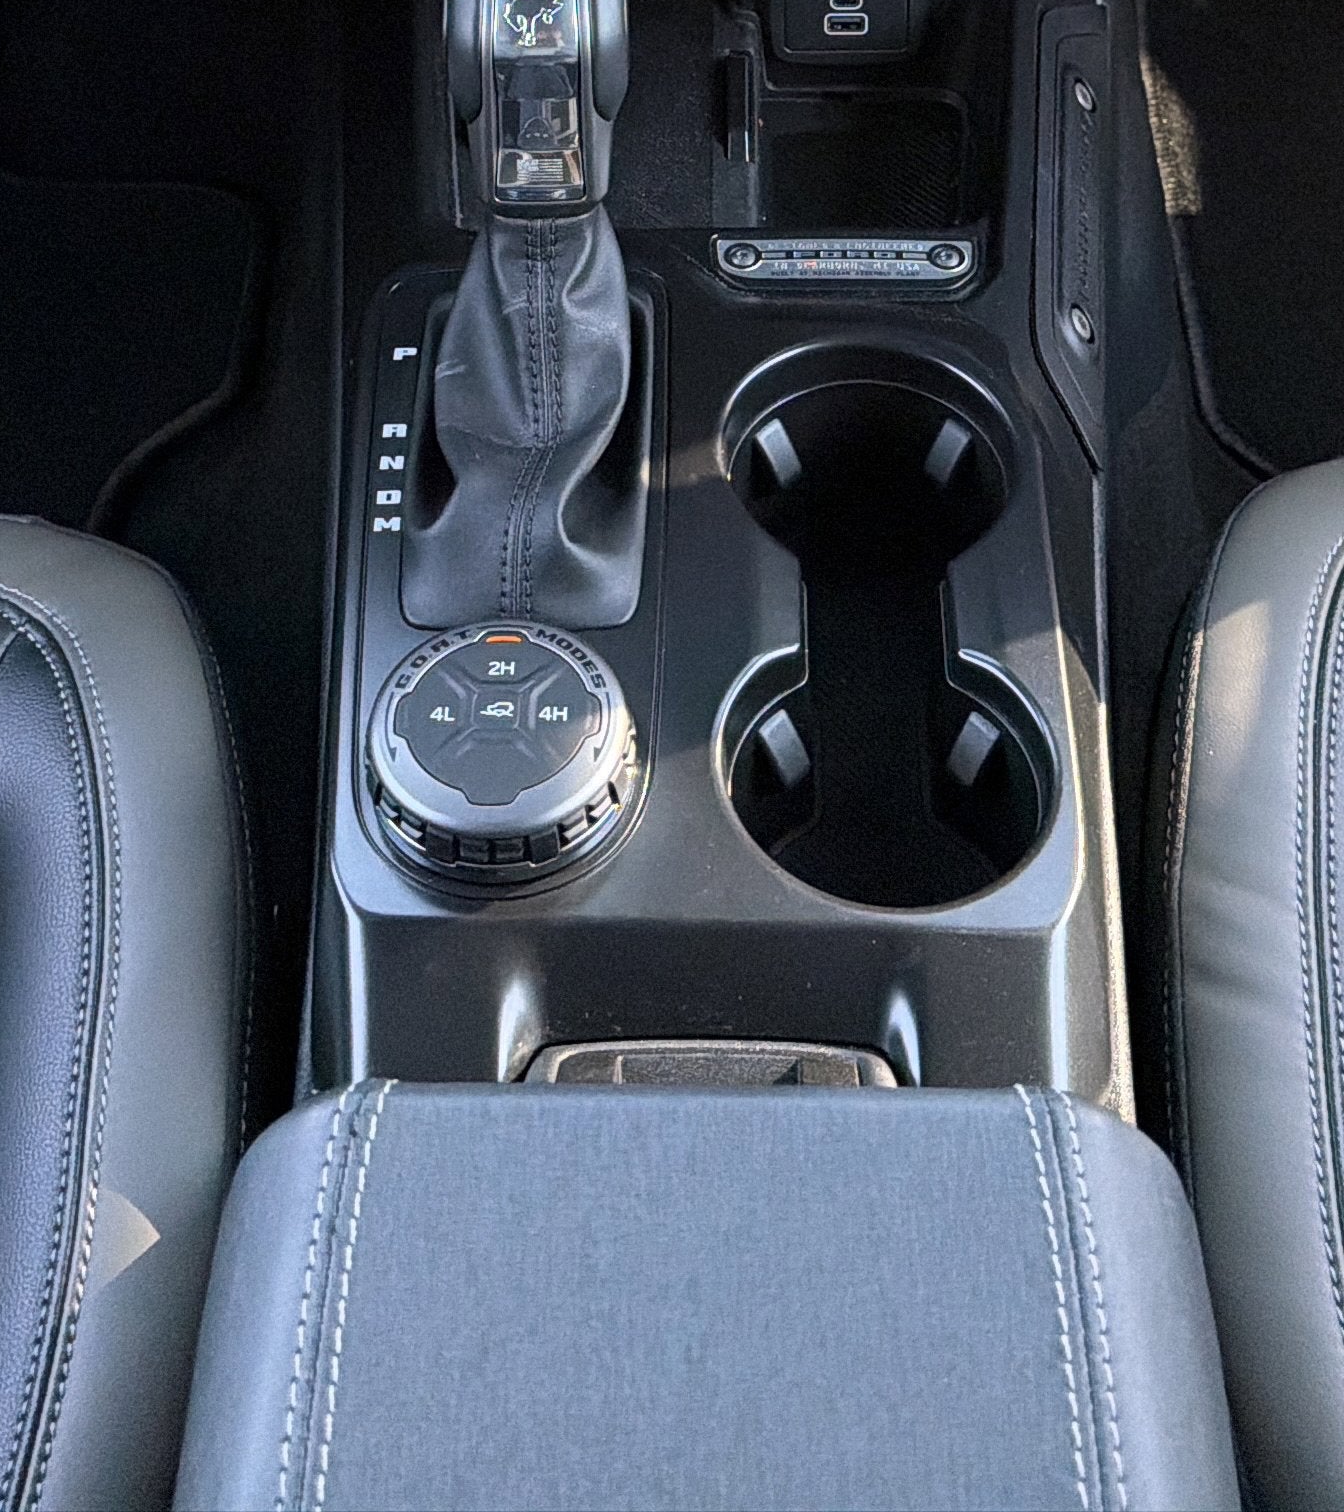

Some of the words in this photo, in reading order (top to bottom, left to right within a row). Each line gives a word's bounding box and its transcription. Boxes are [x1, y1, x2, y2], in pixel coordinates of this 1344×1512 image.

[393, 347, 418, 361] P
[379, 455, 405, 470] N
[376, 489, 402, 505] D
[373, 516, 401, 532] M
[536, 628, 606, 689] MODES
[488, 661, 516, 676] 2H
[429, 705, 456, 722] 4L
[538, 706, 569, 722] 4H
